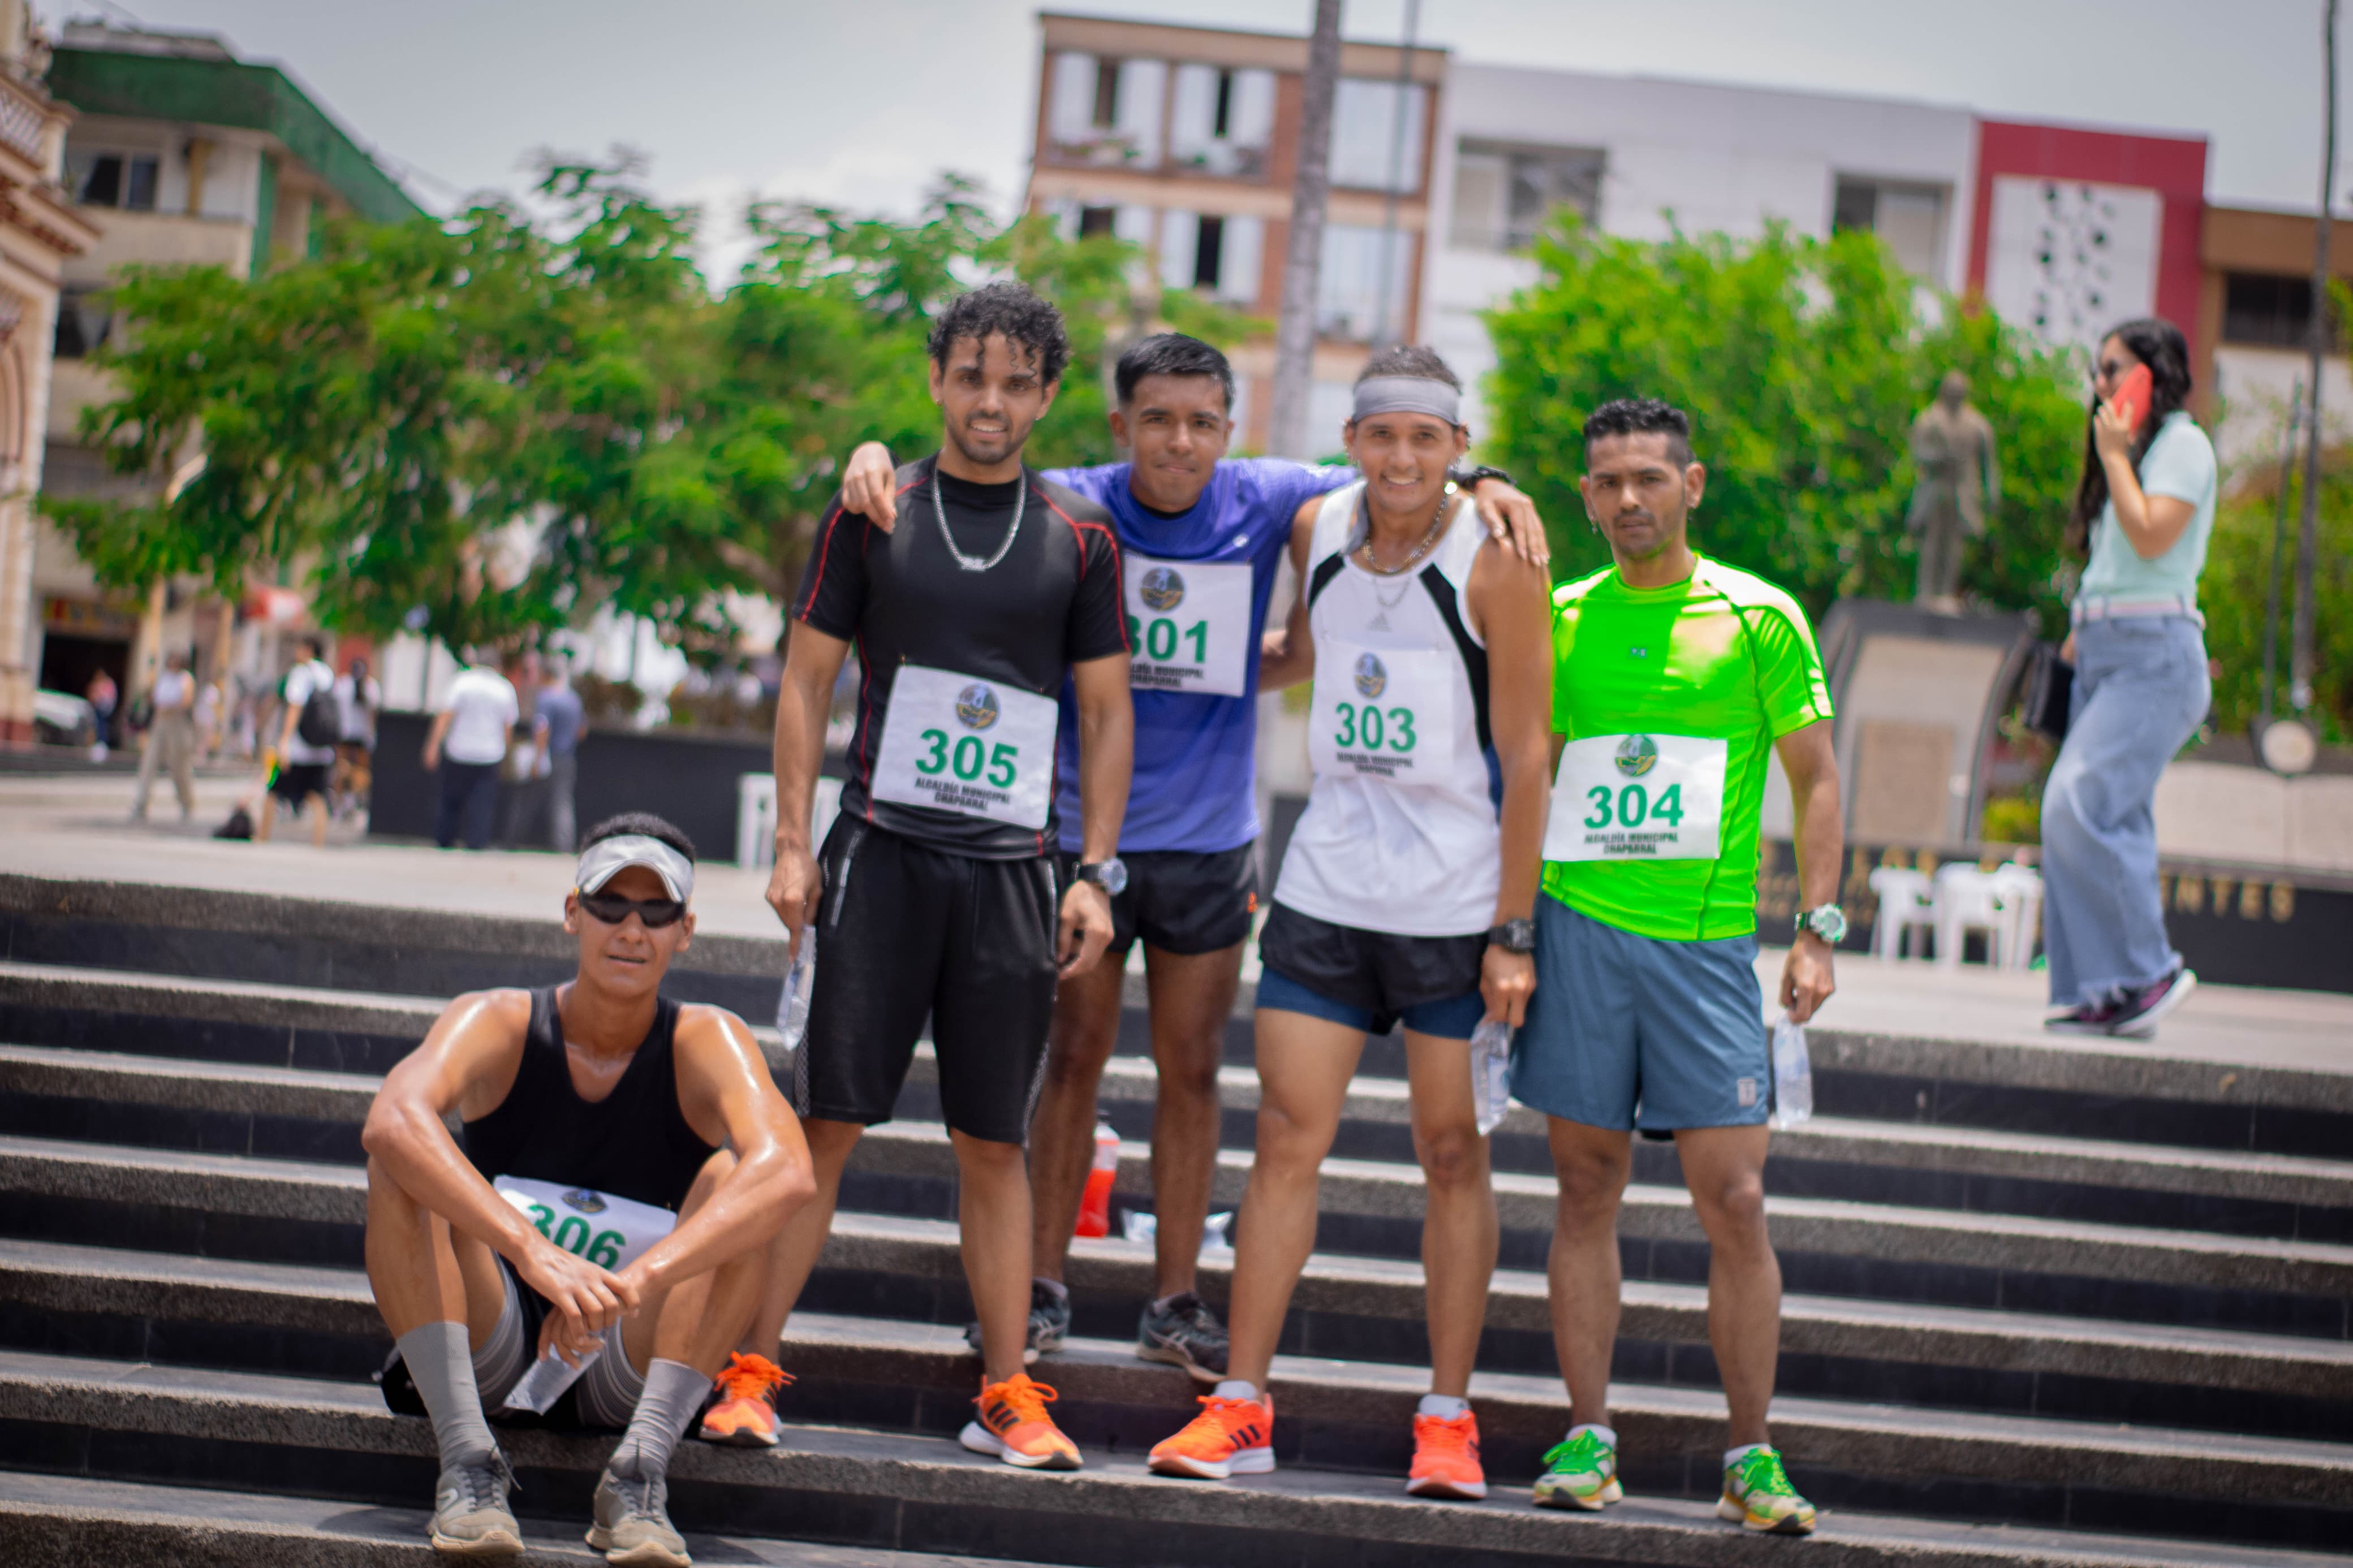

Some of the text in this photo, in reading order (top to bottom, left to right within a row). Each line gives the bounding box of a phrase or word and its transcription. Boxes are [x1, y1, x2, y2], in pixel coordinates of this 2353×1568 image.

[1334, 702, 1417, 753] 303
[915, 728, 1019, 789] 305
[1584, 784, 1684, 828] 304
[1604, 844, 1657, 854] CHAPARRAL
[1628, 832, 1678, 843] MUNICIPAL
[527, 1204, 627, 1270] 306
